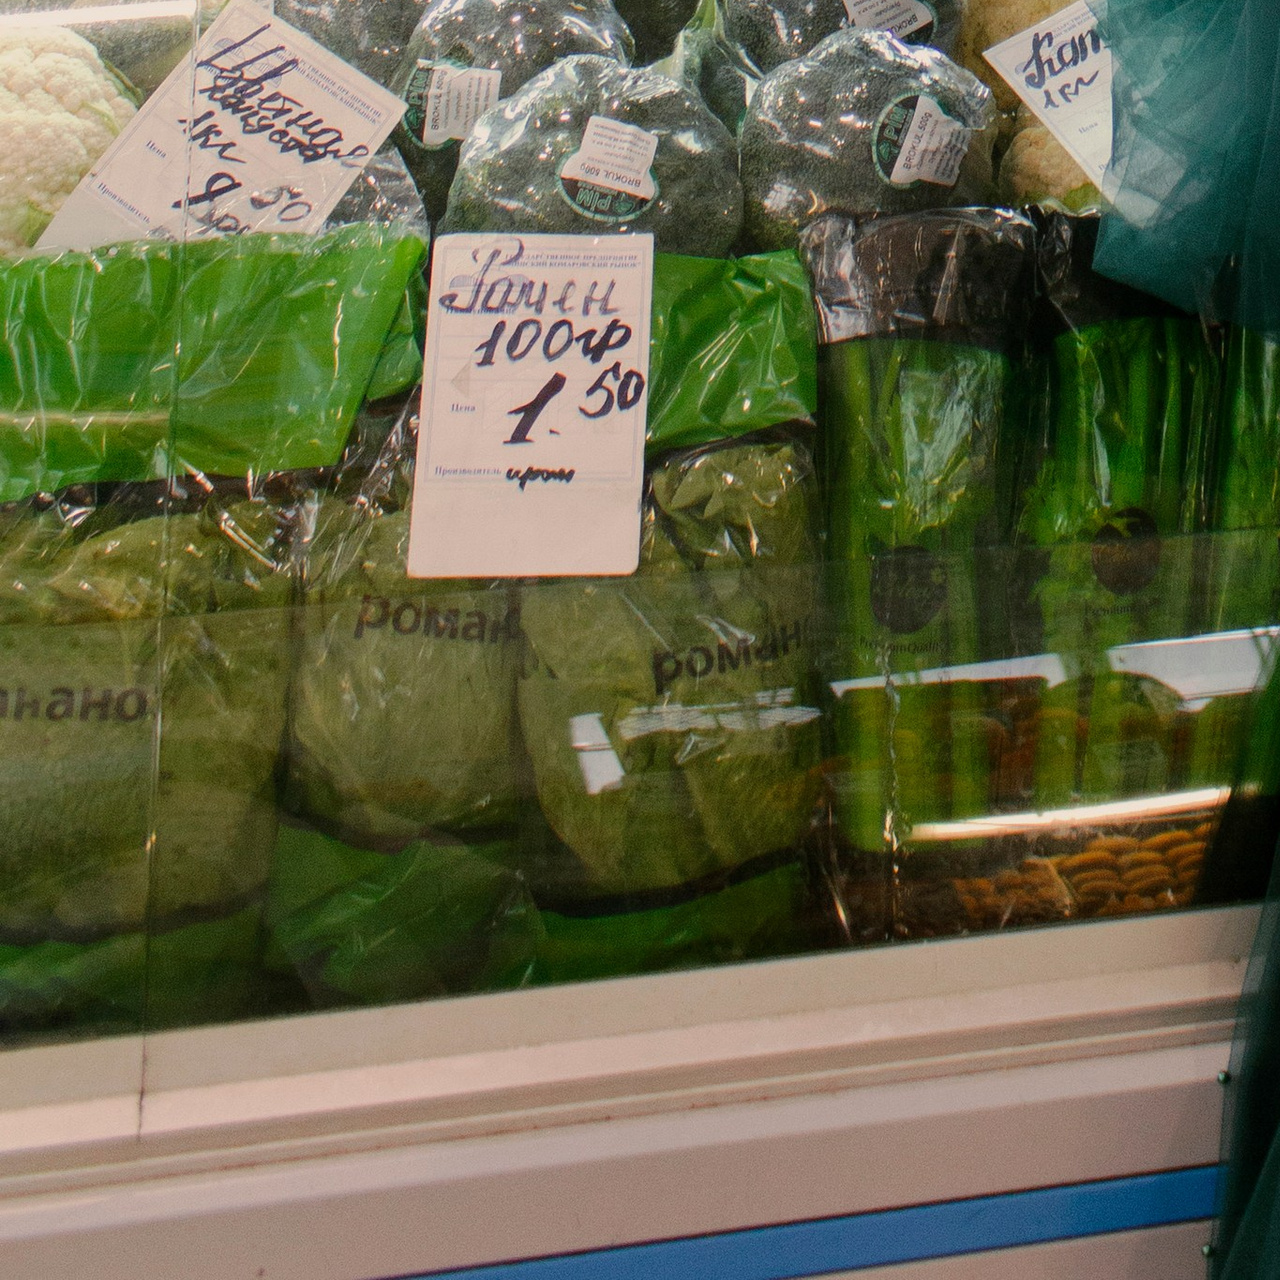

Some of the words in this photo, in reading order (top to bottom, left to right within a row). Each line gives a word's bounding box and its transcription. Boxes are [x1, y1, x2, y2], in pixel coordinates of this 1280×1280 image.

[1022, 28, 1101, 90] Кап
[144, 139, 168, 159] Цена
[96, 180, 152, 224] Производитель
[450, 402, 477, 414] Цена
[434, 465, 502, 477] Производитель
